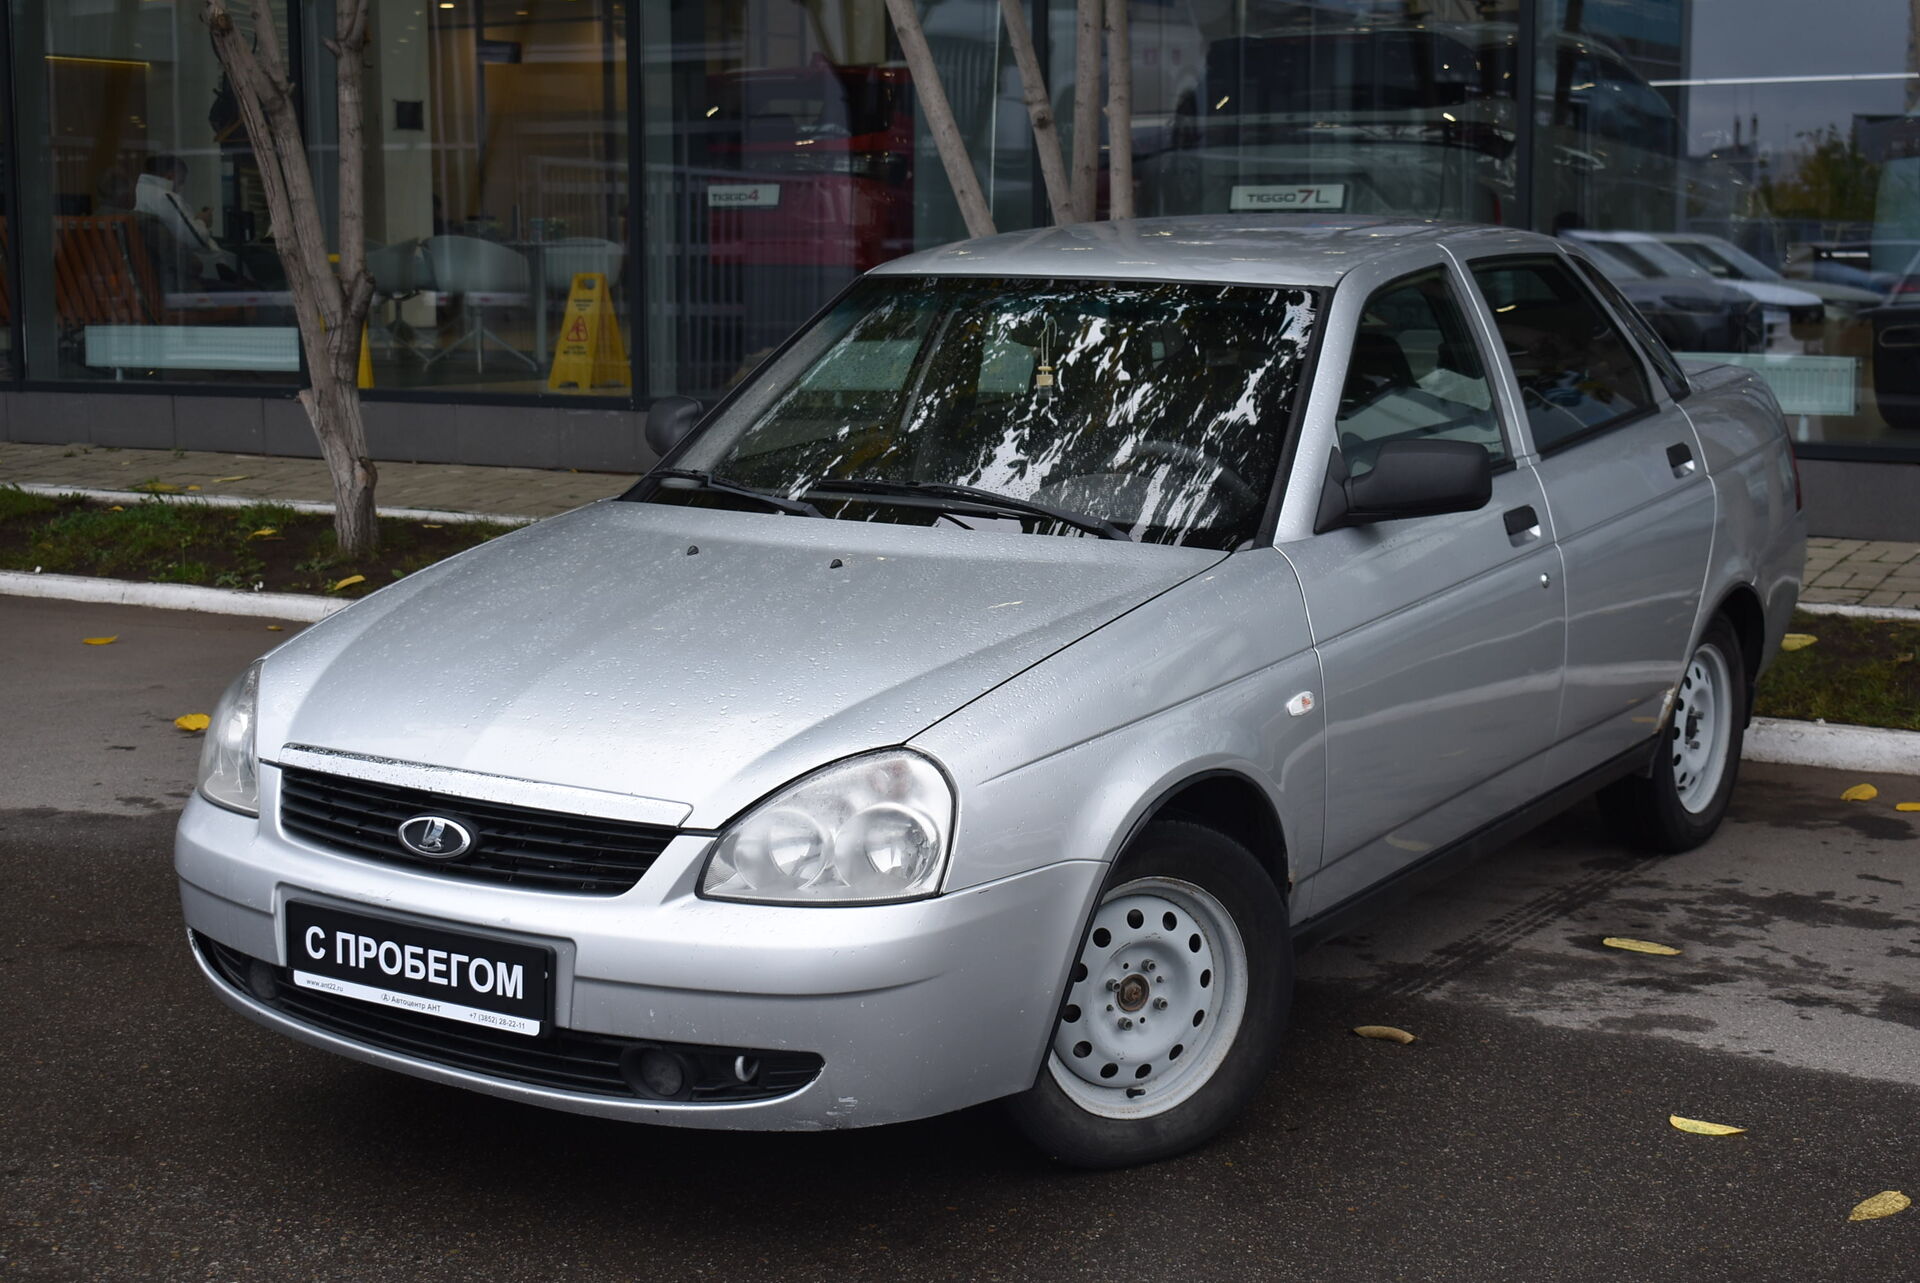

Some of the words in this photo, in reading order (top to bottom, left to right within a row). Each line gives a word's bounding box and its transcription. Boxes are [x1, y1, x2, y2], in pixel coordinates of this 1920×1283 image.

[305, 926, 326, 959] С
[336, 931, 523, 999] ПРОБЕГОМ
[306, 979, 344, 992] www.ant22.ru
[391, 995, 426, 1010] Автоцентр
[427, 1003, 441, 1012] АНТ
[478, 1014, 498, 1025] (3852)
[499, 1017, 525, 1029] 28-22-11
